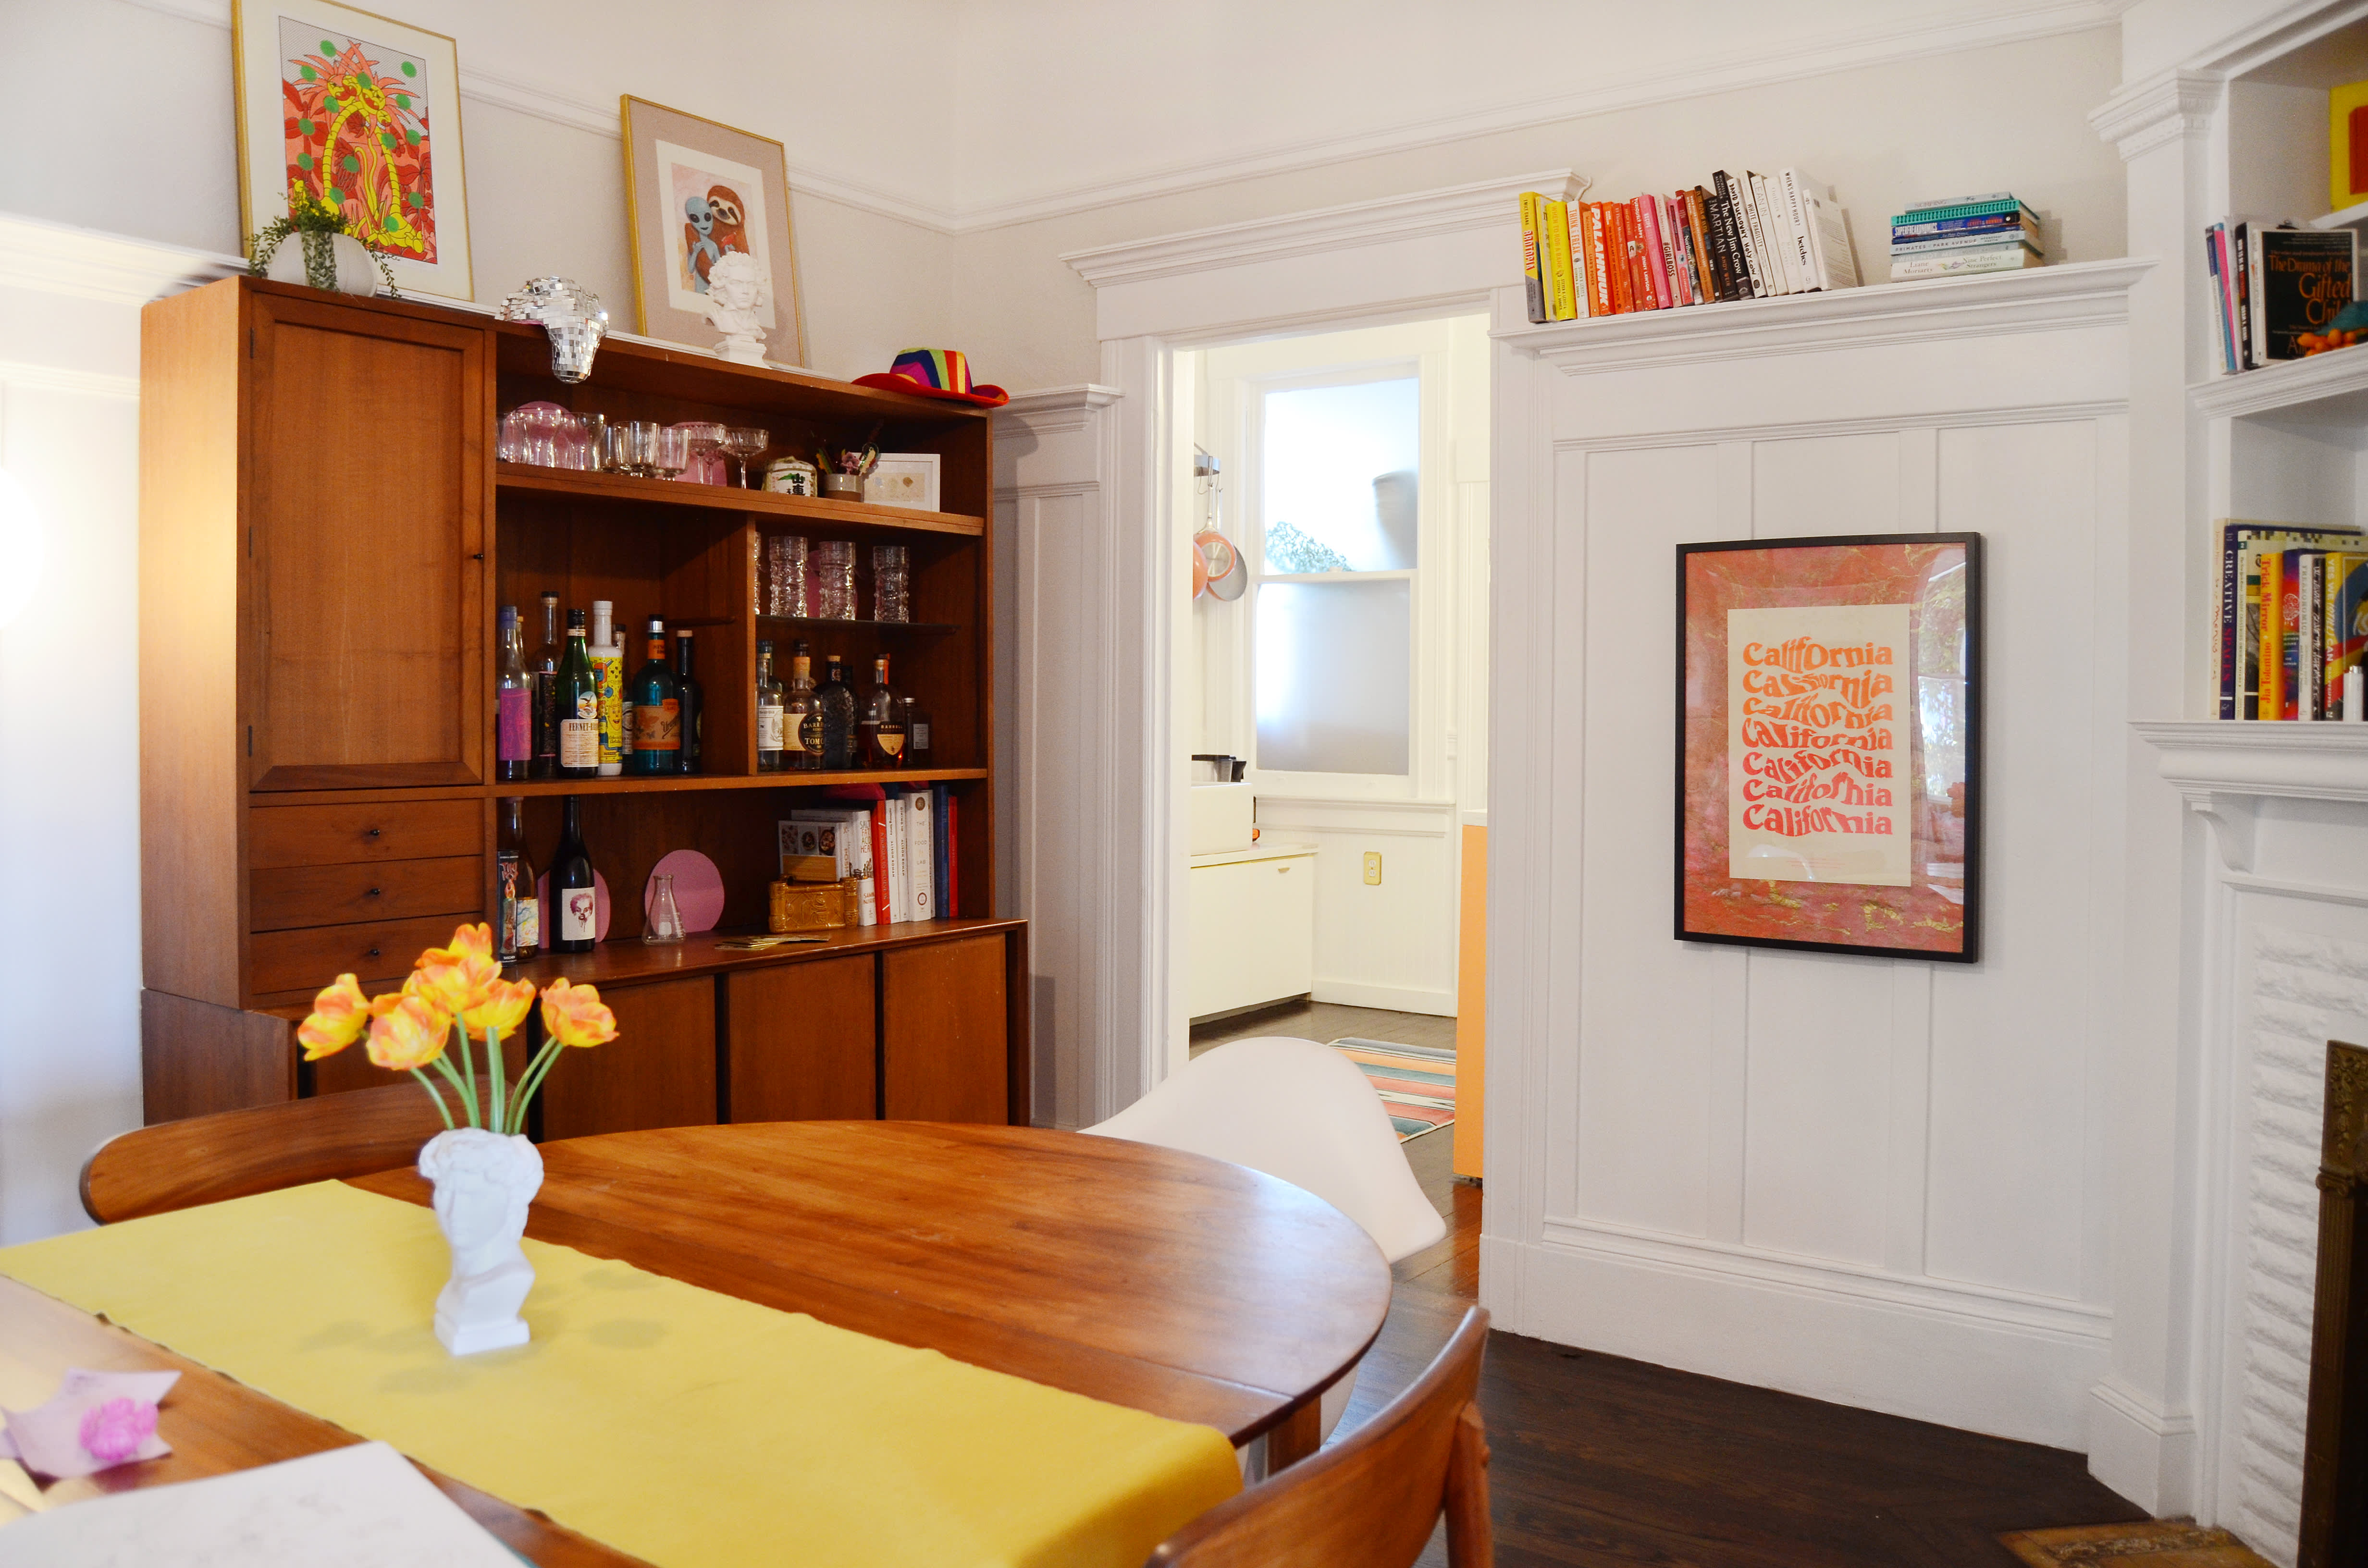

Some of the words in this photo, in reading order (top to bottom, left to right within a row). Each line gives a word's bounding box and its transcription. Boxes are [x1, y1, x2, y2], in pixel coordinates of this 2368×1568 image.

[1785, 172, 1793, 191] WHEN'S
[1721, 200, 1729, 217] The
[1729, 183, 1738, 201] DAVID
[1735, 202, 1748, 239] DUCHOVNY
[1753, 182, 1765, 207] LEAN
[1760, 207, 1768, 217] IN
[1788, 191, 1796, 208] HAPPY
[1569, 209, 1578, 228] THINK
[1709, 203, 1726, 253] MARTIAN
[1725, 217, 1734, 237] New
[1748, 203, 1756, 220] WHITE
[1752, 221, 1764, 247] FRAGILITY
[1791, 209, 1800, 226] HOUR?
[1895, 222, 1937, 236] SUPERFREAKONOMICS
[1523, 231, 1535, 270] BROTOPIA
[1572, 233, 1581, 254] FREAK
[1591, 208, 1608, 306] PALAHNIUK
[1663, 242, 1675, 277] #GIRLBOSS
[1727, 237, 1738, 252] Jim
[1797, 236, 1807, 265] betches
[1732, 252, 1742, 274] Crow
[2268, 255, 2287, 272] The
[2299, 272, 2352, 299] Gifted
[2223, 550, 2234, 624] CREATIVE
[2261, 559, 2271, 588] Trick
[2328, 582, 2334, 600] WE
[2260, 593, 2272, 633] Mirror
[1743, 637, 1893, 673] California
[2223, 627, 2232, 682] SPACES
[2261, 642, 2272, 683] Tolentino
[1743, 670, 1893, 709] California
[2260, 686, 2271, 703] Jia
[1743, 692, 1893, 729] California
[1742, 718, 1893, 750] California
[1743, 748, 1893, 784] California
[1743, 772, 1893, 807] California
[1743, 804, 1893, 837] California
